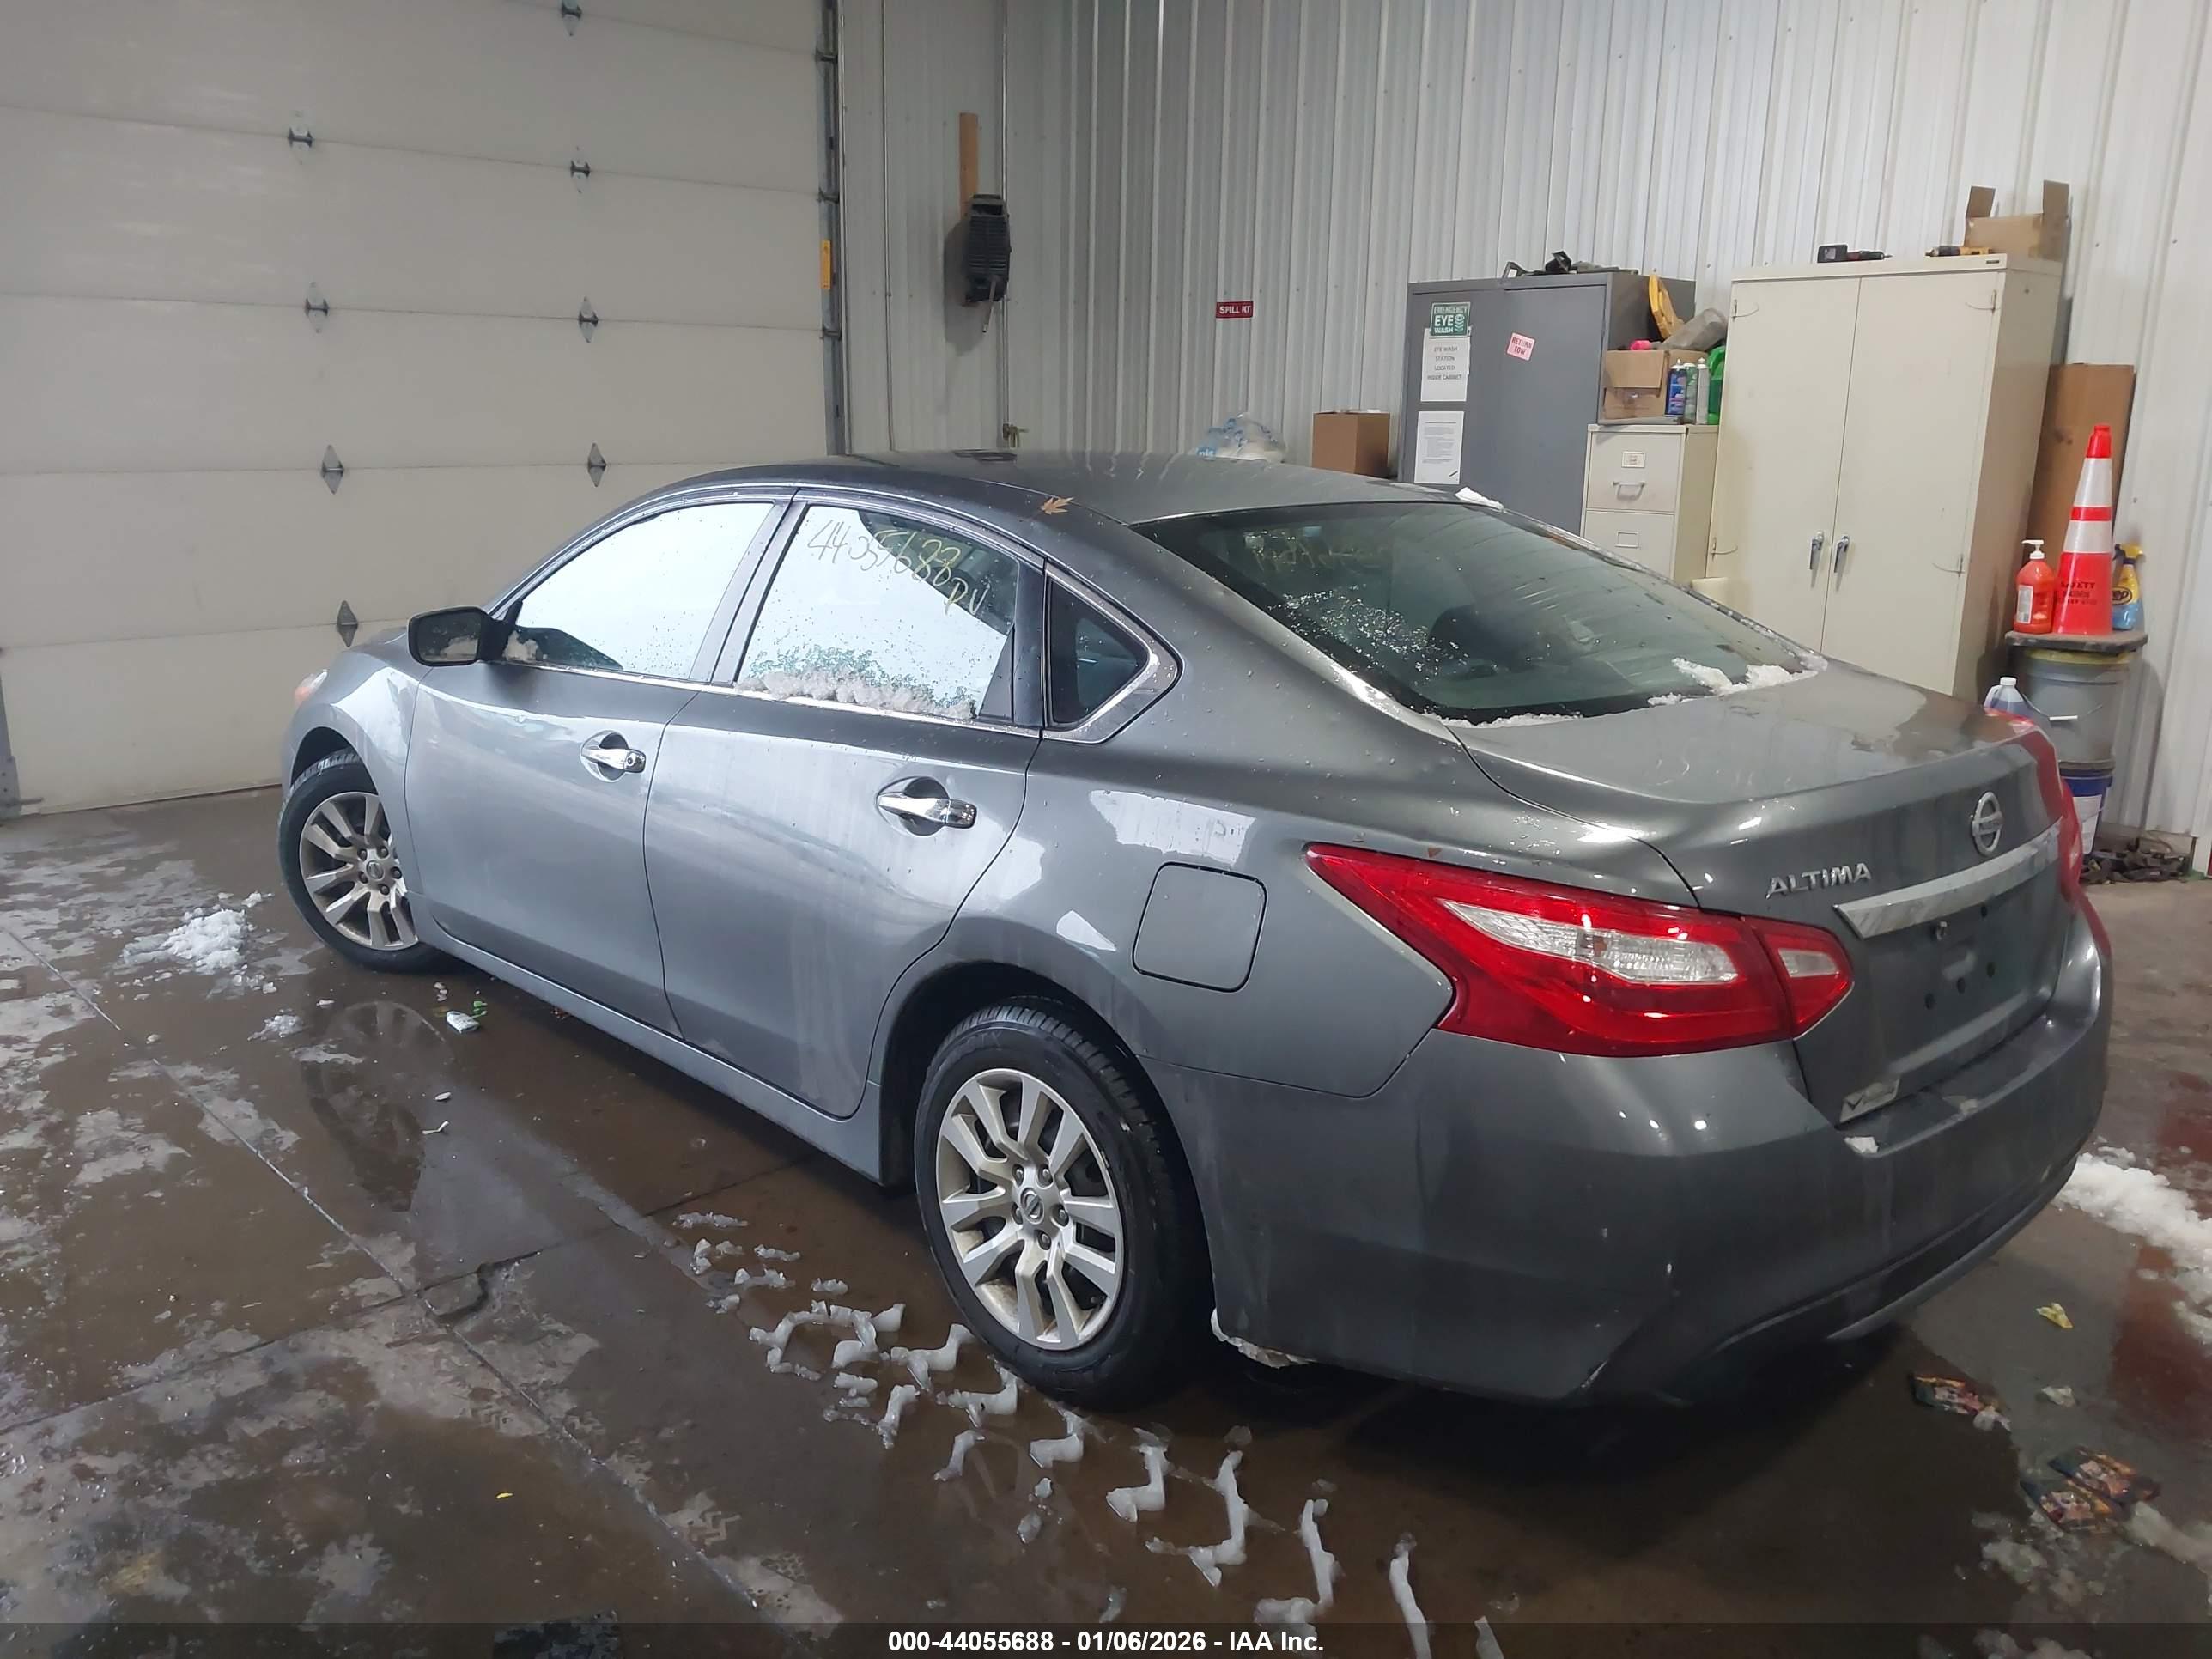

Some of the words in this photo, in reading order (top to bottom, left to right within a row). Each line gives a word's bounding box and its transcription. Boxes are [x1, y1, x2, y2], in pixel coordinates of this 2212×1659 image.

[1219, 306, 1241, 314] SPILL
[1434, 314, 1455, 326] EYE
[1511, 337, 1533, 349] RETURN
[1514, 345, 1527, 356] TOW
[1765, 862, 1872, 899] ALTIMA
